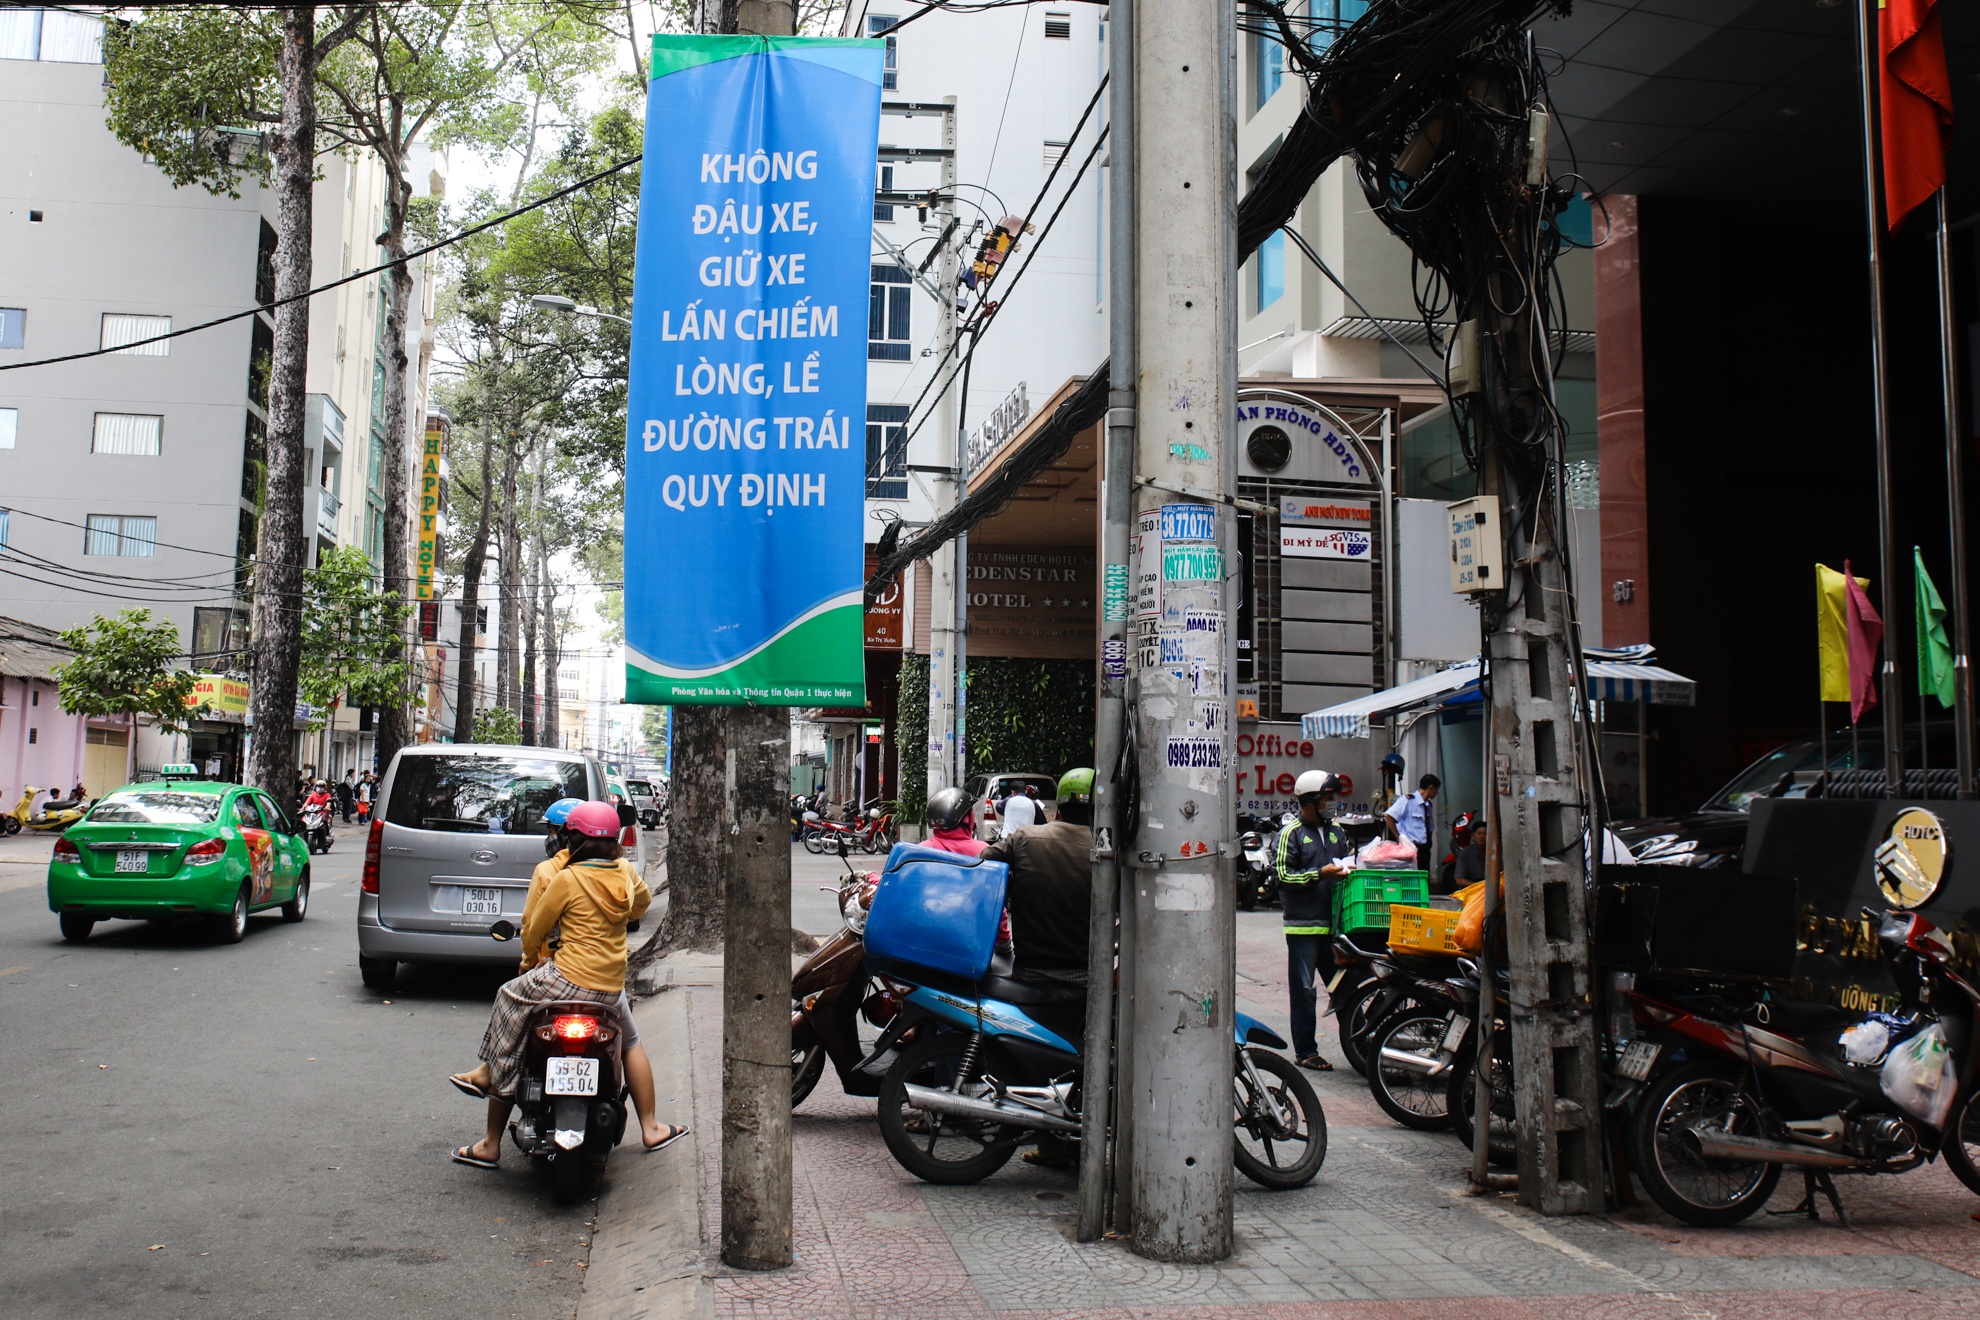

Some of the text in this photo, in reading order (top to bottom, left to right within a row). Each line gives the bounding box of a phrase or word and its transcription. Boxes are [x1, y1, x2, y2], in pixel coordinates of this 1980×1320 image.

[700, 148, 818, 184] KHÔNG
[692, 198, 818, 244] ĐẬU XE,
[699, 249, 806, 287] GIỮ XE
[661, 296, 838, 342] LẤN CHIẾM
[675, 350, 821, 400] LÒNG, LỀ
[642, 409, 850, 452] ĐƯỜNG TRÁI
[1265, 407, 1321, 435] PHÒNG
[1323, 432, 1360, 477] HDTC
[422, 439, 440, 530] HAPPY
[662, 473, 826, 517] QUY ĐỊNH
[1283, 538, 1294, 546] ĐI
[993, 553, 1019, 563] TNHH
[1021, 554, 1046, 564] EDEN
[1048, 556, 1078, 565] HOTEL
[418, 540, 434, 597] HOTEL
[1144, 574, 1157, 582] CAO
[876, 627, 886, 635] 40
[671, 687, 852, 698] Phòng Văn hóa và Thông tin Quận 1 thực hiện
[1237, 733, 1315, 757] Office
[1248, 801, 1260, 809] 62
[1903, 825, 1936, 839] HDTC
[124, 851, 141, 861] 51F
[471, 889, 495, 900] 50LD
[466, 902, 497, 913] 030.16
[555, 1062, 591, 1076] 59-G2
[549, 1077, 594, 1092] 155.04
